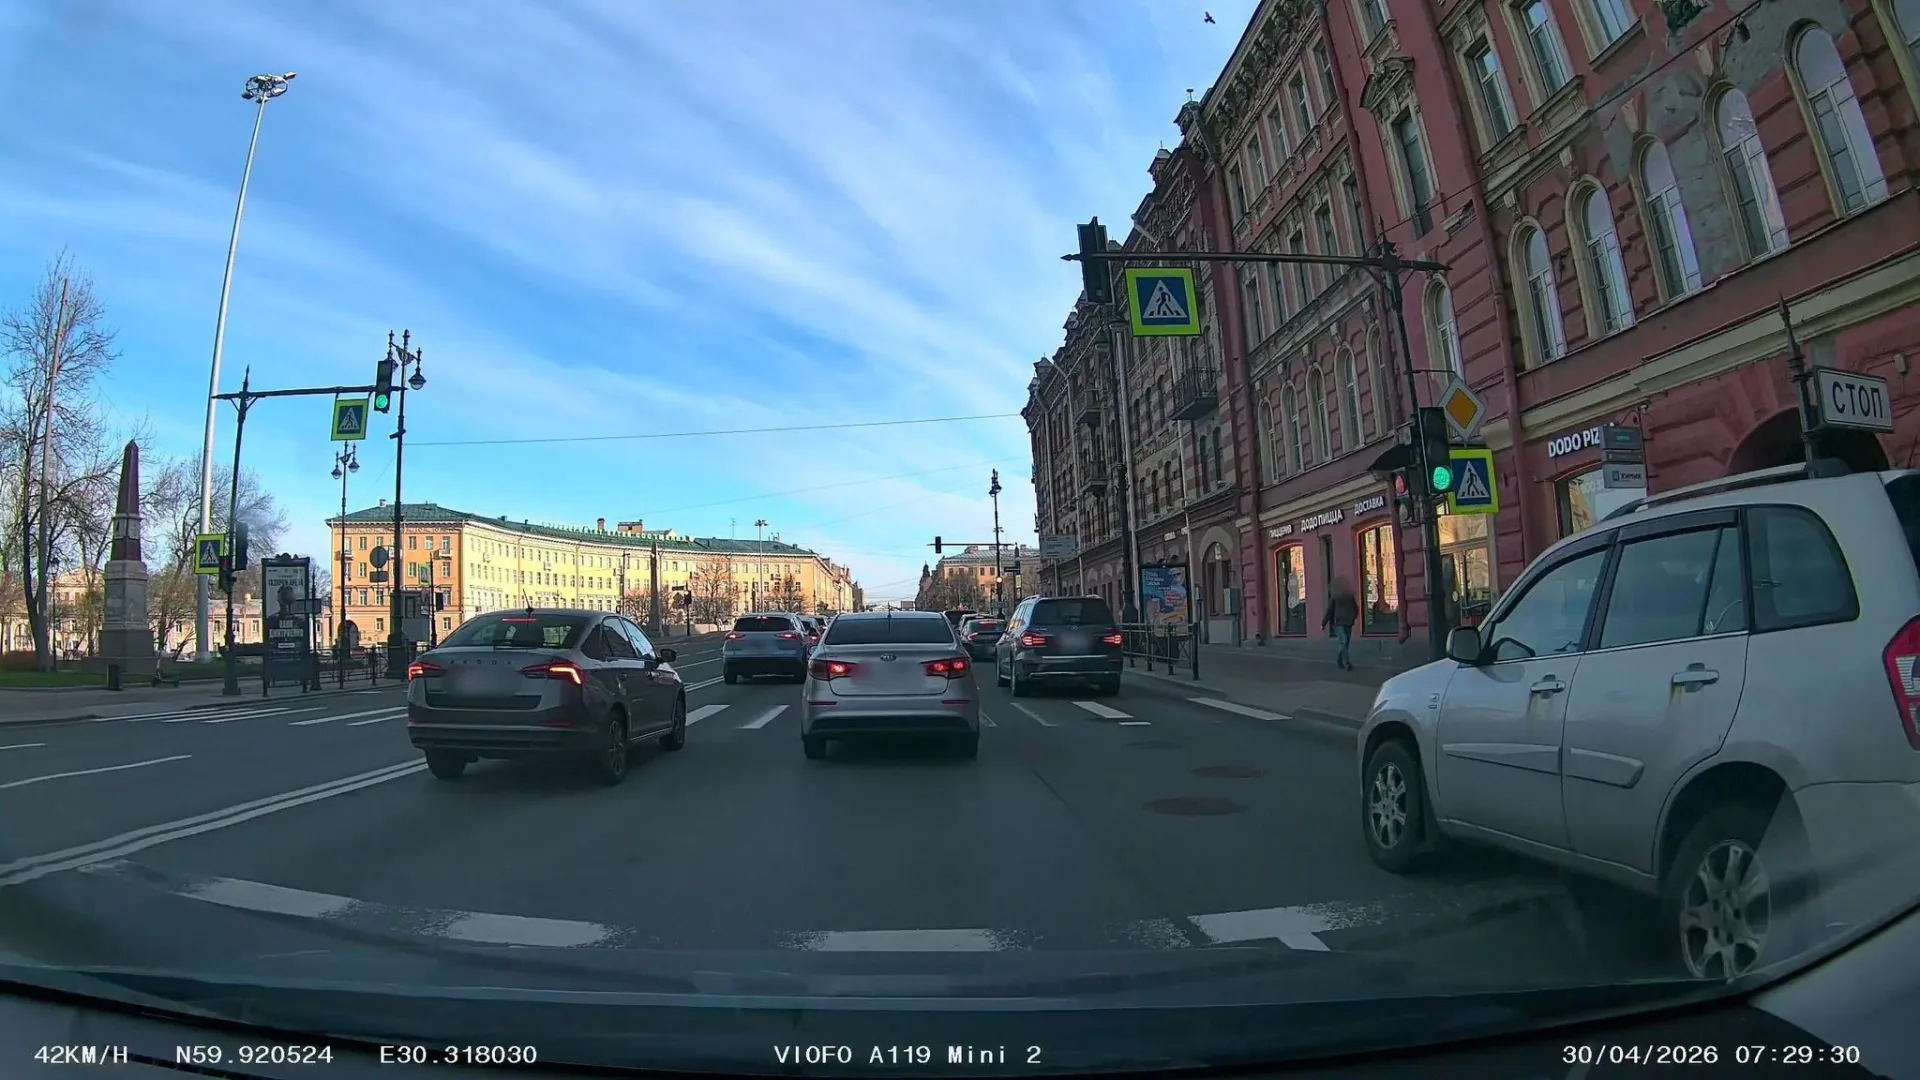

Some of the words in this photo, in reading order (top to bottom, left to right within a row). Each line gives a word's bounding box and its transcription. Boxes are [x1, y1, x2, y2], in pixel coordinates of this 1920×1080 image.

[1832, 381, 1883, 419] СТОП
[1548, 433, 1582, 457] DODO
[1582, 424, 1606, 447] PIZ
[1354, 496, 1384, 515] ДОСТАВКА
[1301, 517, 1318, 533] ДОДО
[1318, 509, 1343, 525] ПИЦЦА
